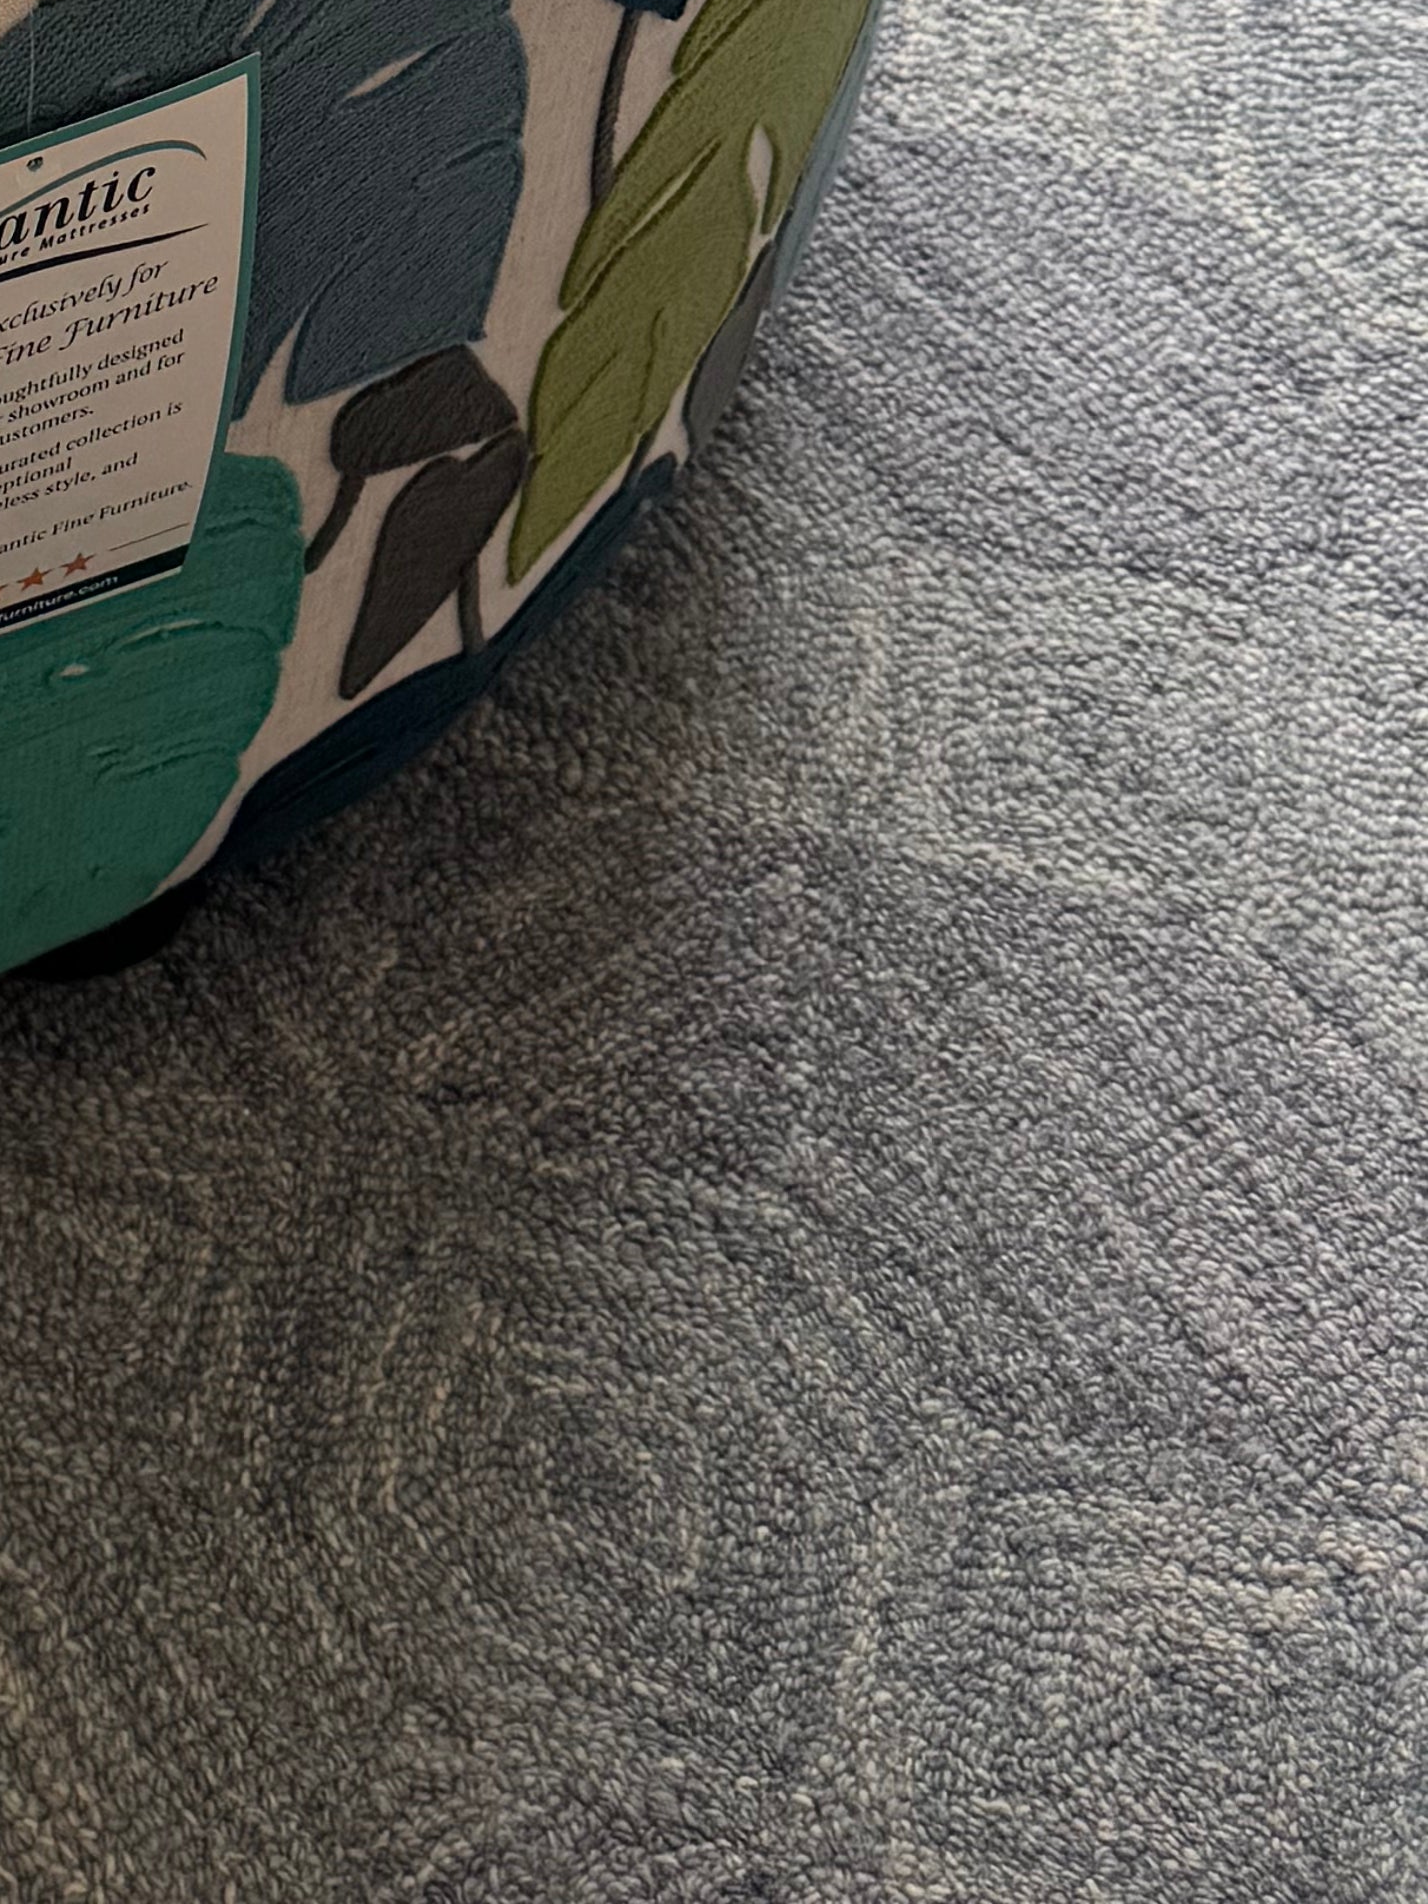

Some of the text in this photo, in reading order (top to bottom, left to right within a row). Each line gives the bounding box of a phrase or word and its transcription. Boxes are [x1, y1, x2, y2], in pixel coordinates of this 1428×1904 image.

[39, 203, 150, 251] Mattresses
[122, 259, 168, 303] for
[58, 275, 218, 351] Furniture
[97, 328, 184, 370] designed
[7, 379, 110, 423] showroom
[115, 361, 151, 385] and
[157, 351, 186, 371] for
[66, 410, 161, 451] collection
[167, 401, 183, 417] is
[45, 471, 96, 495] style,
[102, 452, 138, 475] and
[52, 513, 94, 536] Fine
